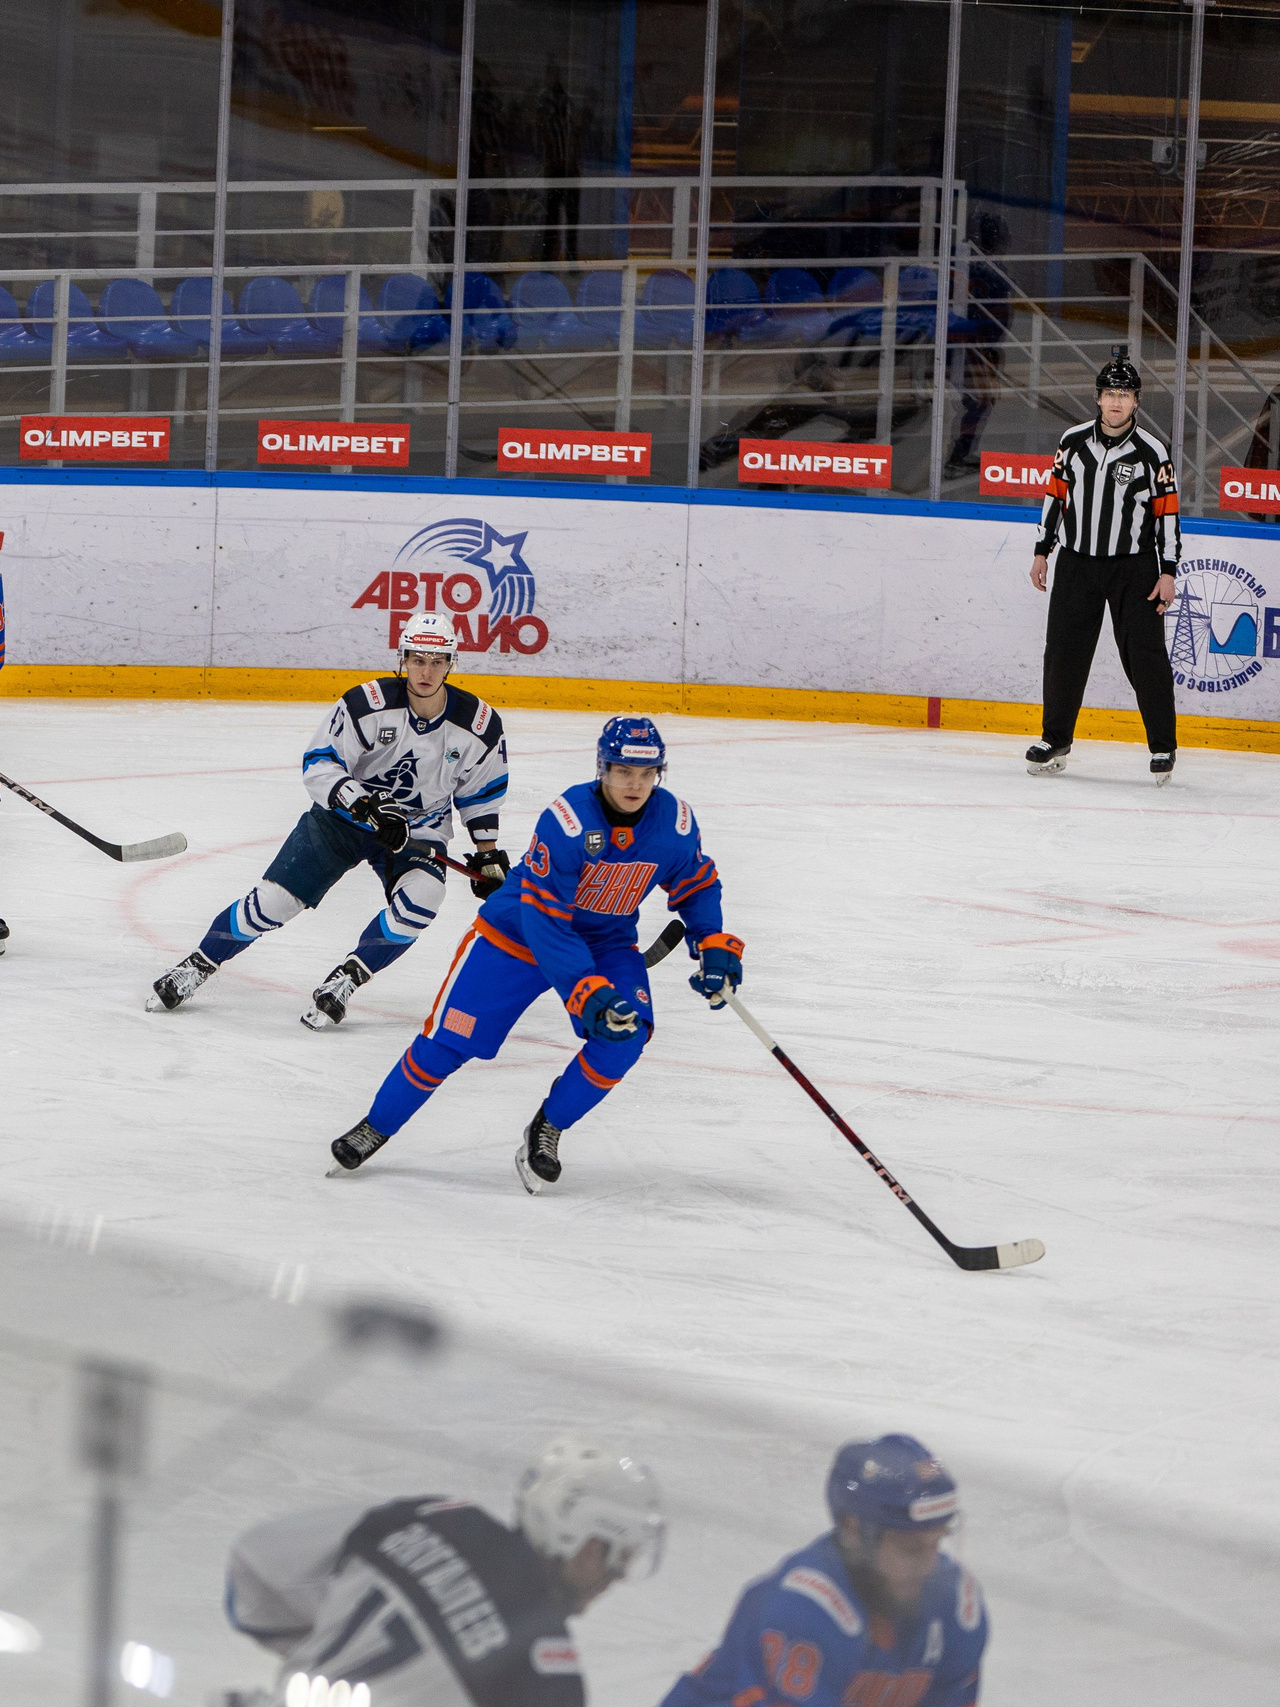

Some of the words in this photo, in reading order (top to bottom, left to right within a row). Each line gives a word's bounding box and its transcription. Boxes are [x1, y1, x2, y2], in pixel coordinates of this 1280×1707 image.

[23, 428, 166, 449] OLIMPBET
[261, 433, 406, 454] OLIMPBET
[501, 440, 648, 464] OLIMPBET
[742, 450, 888, 476] OLIMPBET
[983, 464, 1052, 486] OLIM
[1175, 558, 1268, 599] ТСТВЕННОСТЬЮ
[350, 570, 482, 613] АВТО
[388, 611, 549, 655] РДИО
[413, 635, 445, 643] OLIMPBET
